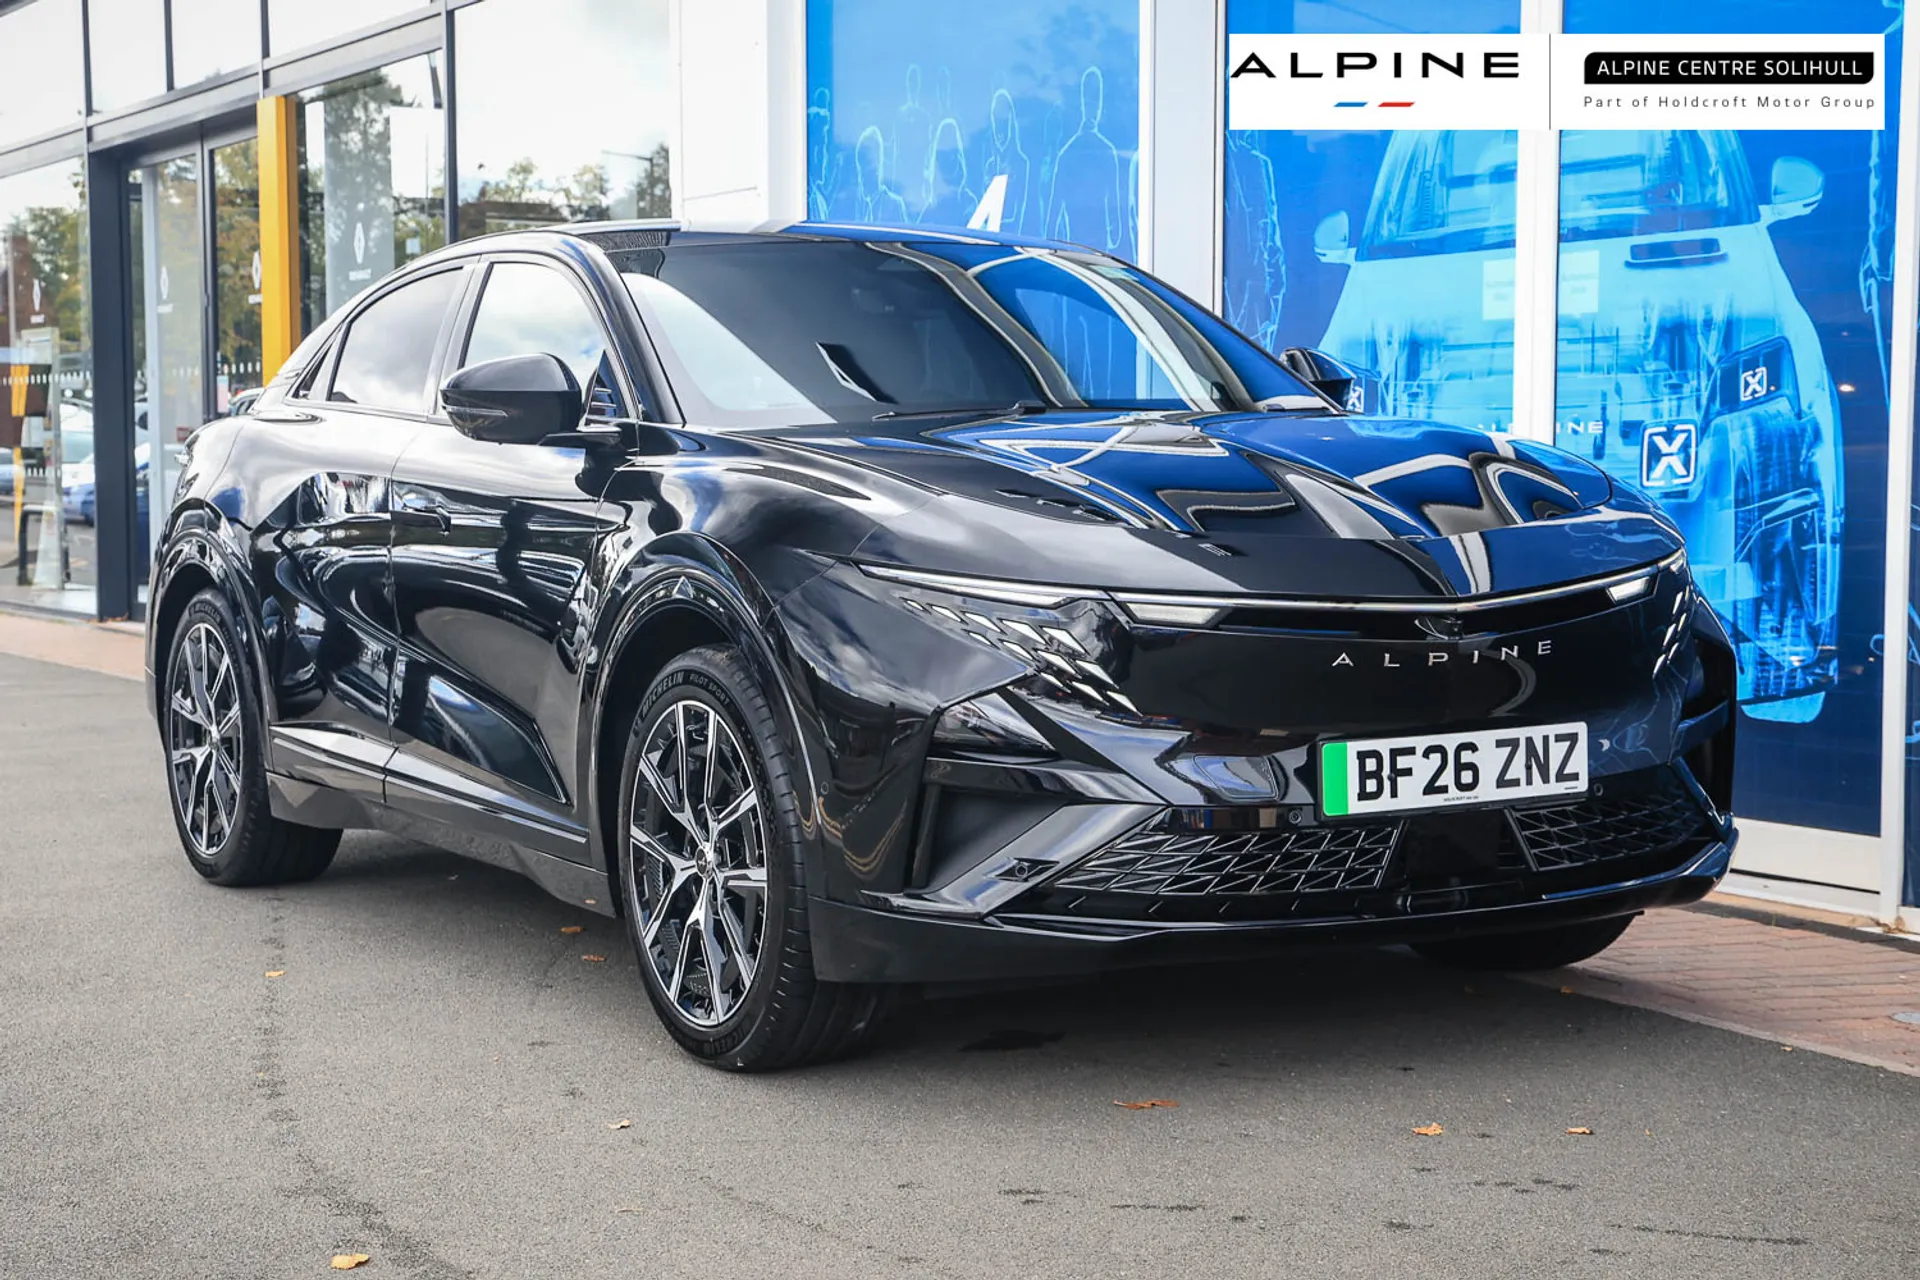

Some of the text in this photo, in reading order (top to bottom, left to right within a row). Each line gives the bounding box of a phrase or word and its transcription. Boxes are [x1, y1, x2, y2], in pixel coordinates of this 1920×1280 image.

[1331, 639, 1553, 668] ALPINE
[641, 670, 730, 718] MICHELIN PILOT SPORT
[1356, 732, 1580, 802] BF26 ZNZ
